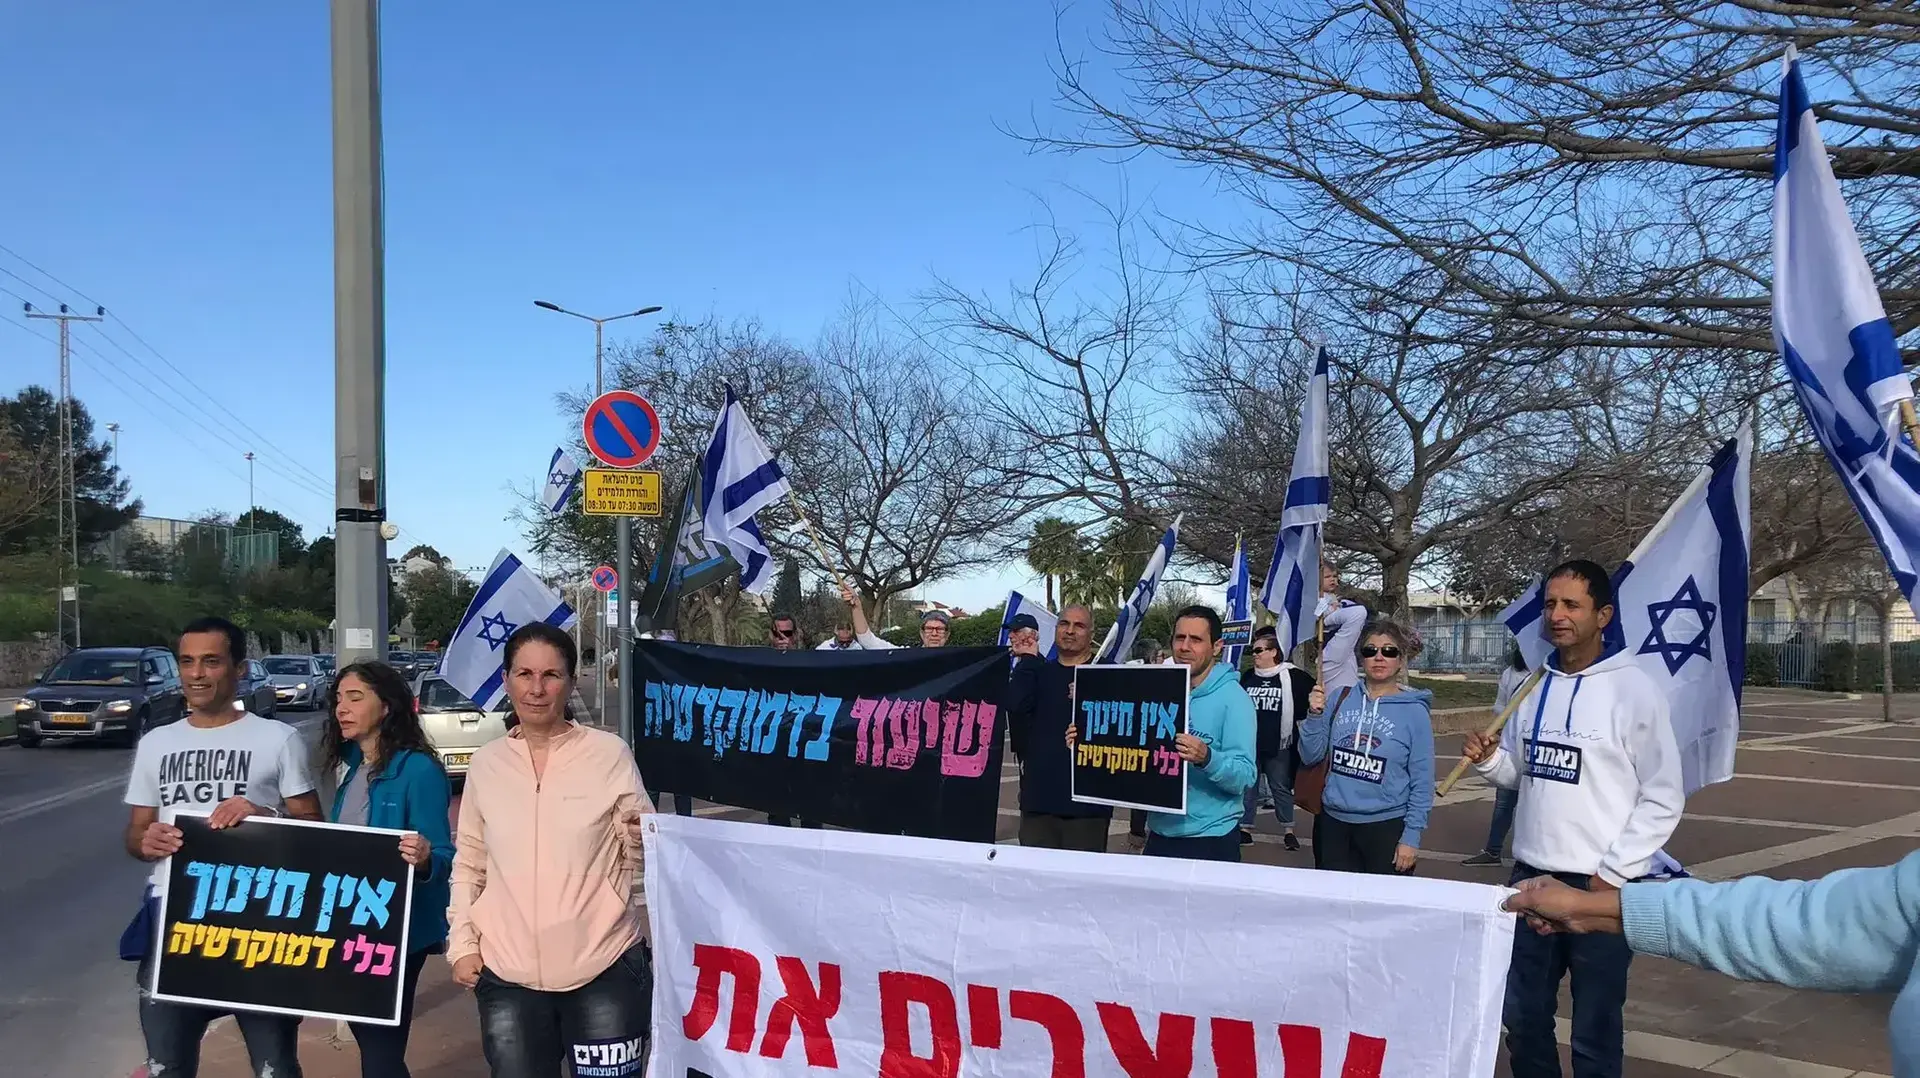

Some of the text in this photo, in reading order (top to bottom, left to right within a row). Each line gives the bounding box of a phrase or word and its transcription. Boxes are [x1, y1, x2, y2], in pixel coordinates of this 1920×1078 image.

[597, 486, 648, 498] והורדת תלמידים
[602, 473, 643, 485] פרט להעלאת
[588, 500, 657, 511] משעה 07:30 עד 08:30
[1246, 687, 1281, 697] חופשי
[1253, 697, 1281, 711] בארצ
[644, 679, 997, 778] שיעור בדמוקרטיה
[1082, 700, 1134, 741] חינוך
[1139, 701, 1179, 745] אין
[159, 749, 252, 786] AMERICAN
[1077, 743, 1180, 776] בלי דמוקרטיה
[1333, 749, 1383, 774] נאמנים
[159, 782, 247, 807] EAGLE
[186, 860, 397, 932] אין חינוך
[168, 921, 397, 976] בלי דמוקרטיה
[682, 943, 840, 1069] את
[573, 1036, 642, 1066] נאמנים
[577, 1060, 641, 1077] גילת העצמאות
